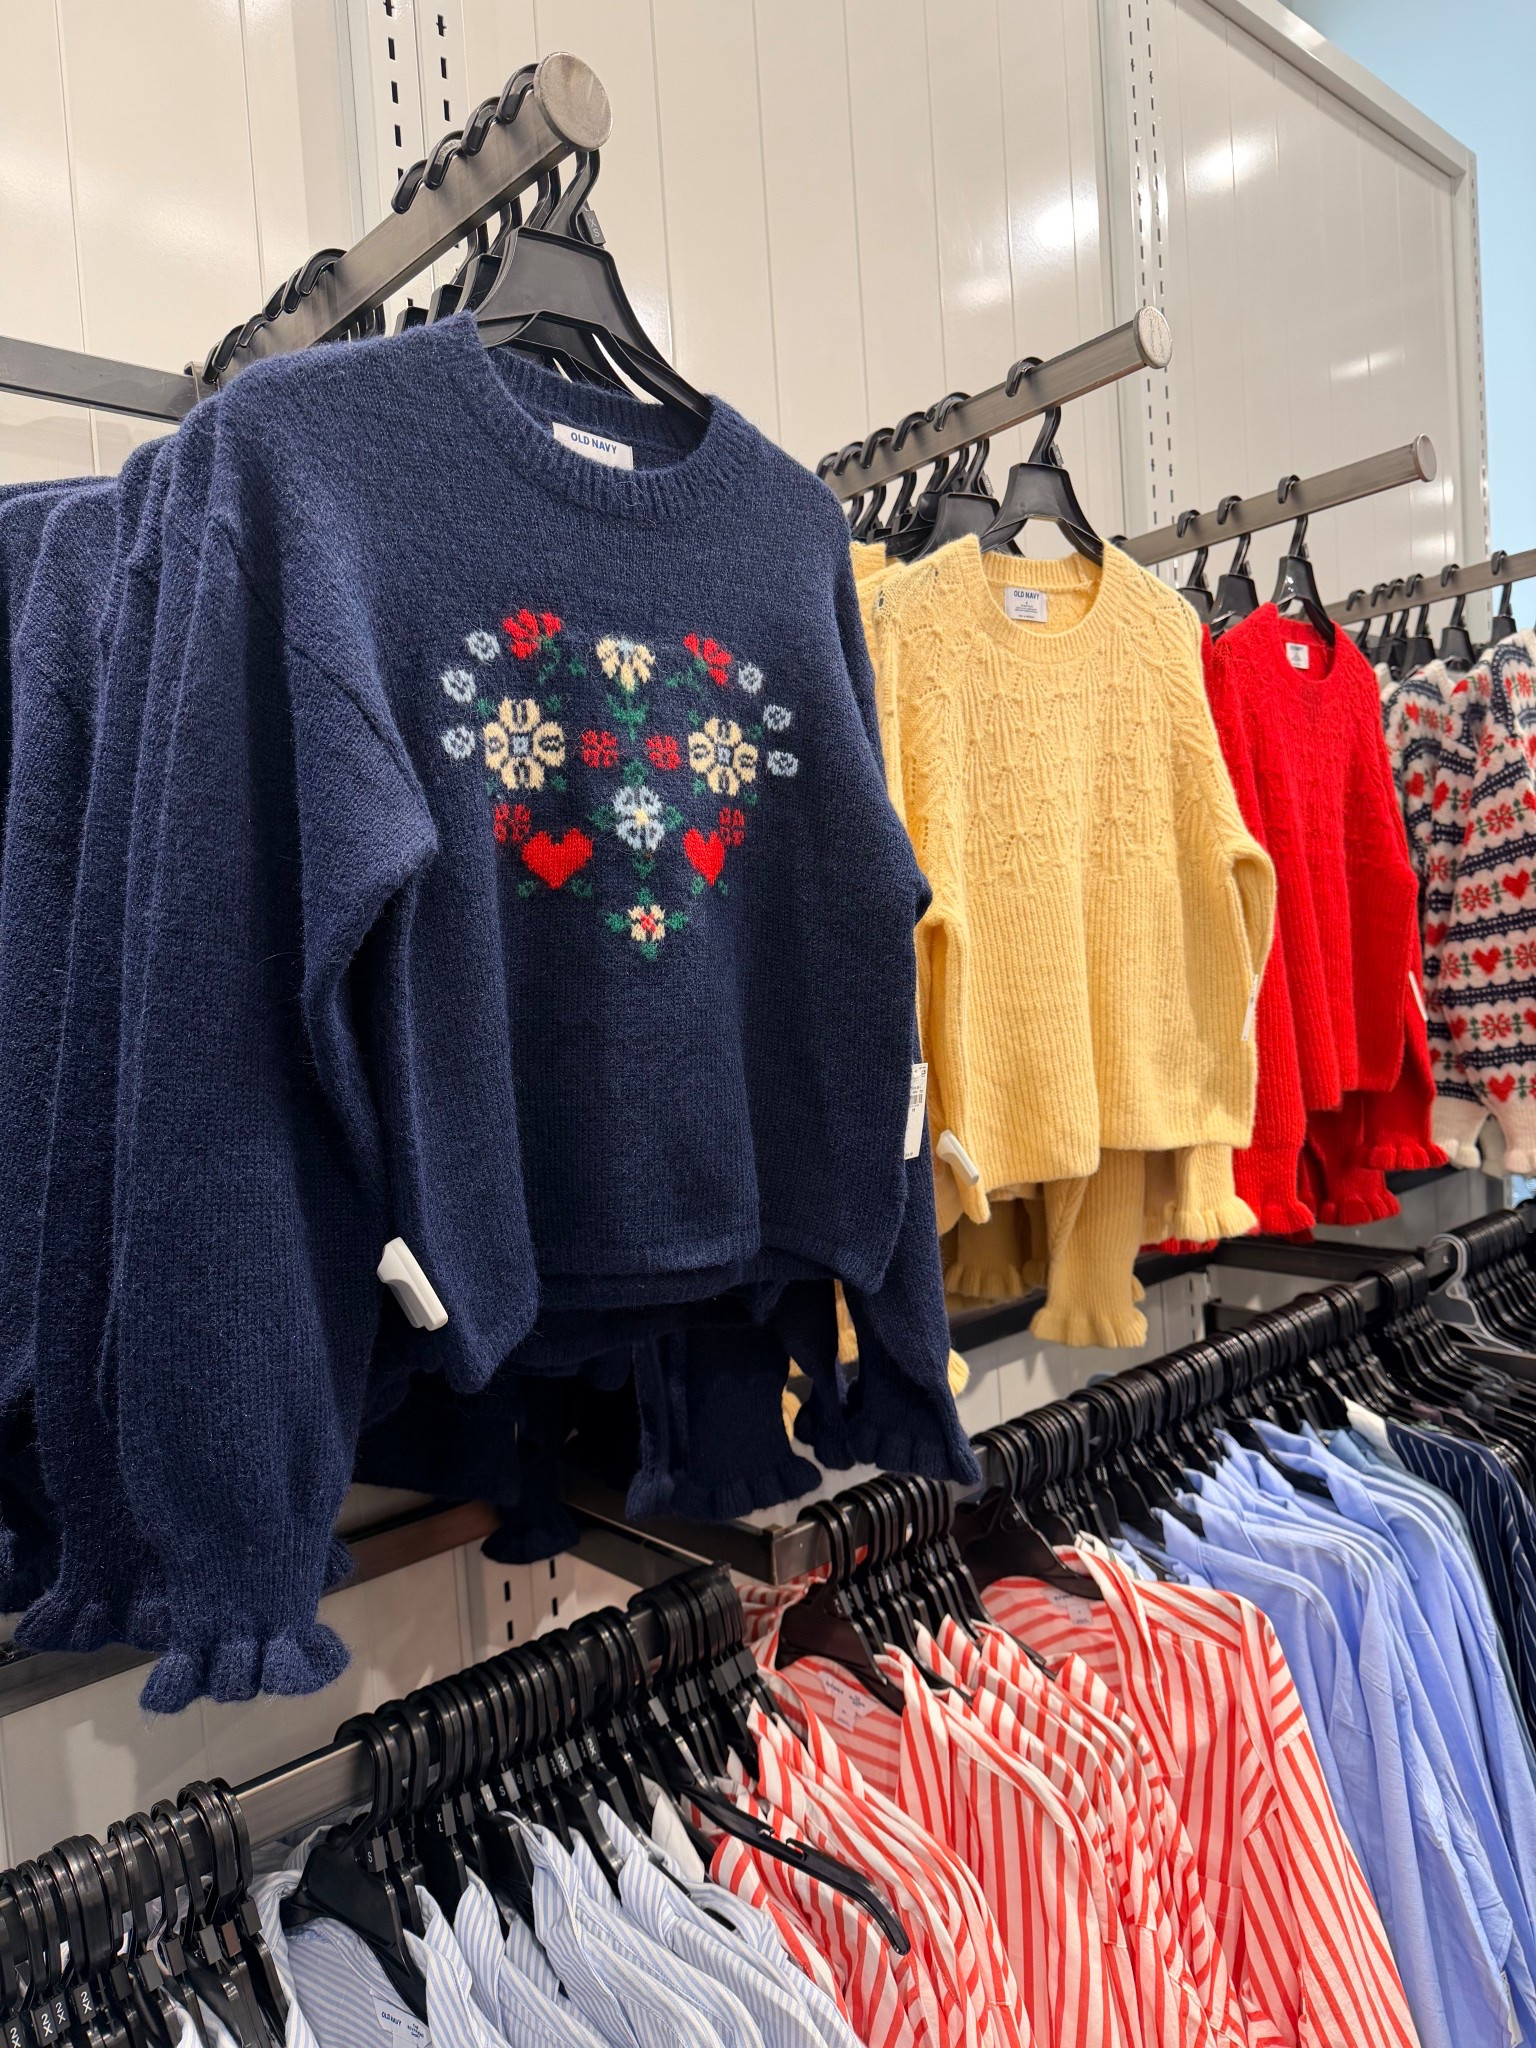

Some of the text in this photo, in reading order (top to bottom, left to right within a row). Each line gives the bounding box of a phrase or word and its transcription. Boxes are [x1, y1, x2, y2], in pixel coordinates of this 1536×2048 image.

[589, 218, 600, 238] XS
[570, 432, 618, 455] OLD NAVY
[1013, 590, 1040, 601] OLD NAVY
[516, 1773, 523, 1784] S
[499, 1785, 506, 1797] S
[436, 1812, 444, 1833] XL
[367, 1851, 373, 1864] S
[80, 1991, 92, 2014] 2X
[55, 2002, 66, 2025] 2X
[381, 2011, 402, 2027] OLD NAVY
[41, 2013, 53, 2037] 2X
[10, 2027, 21, 2048] 2X
